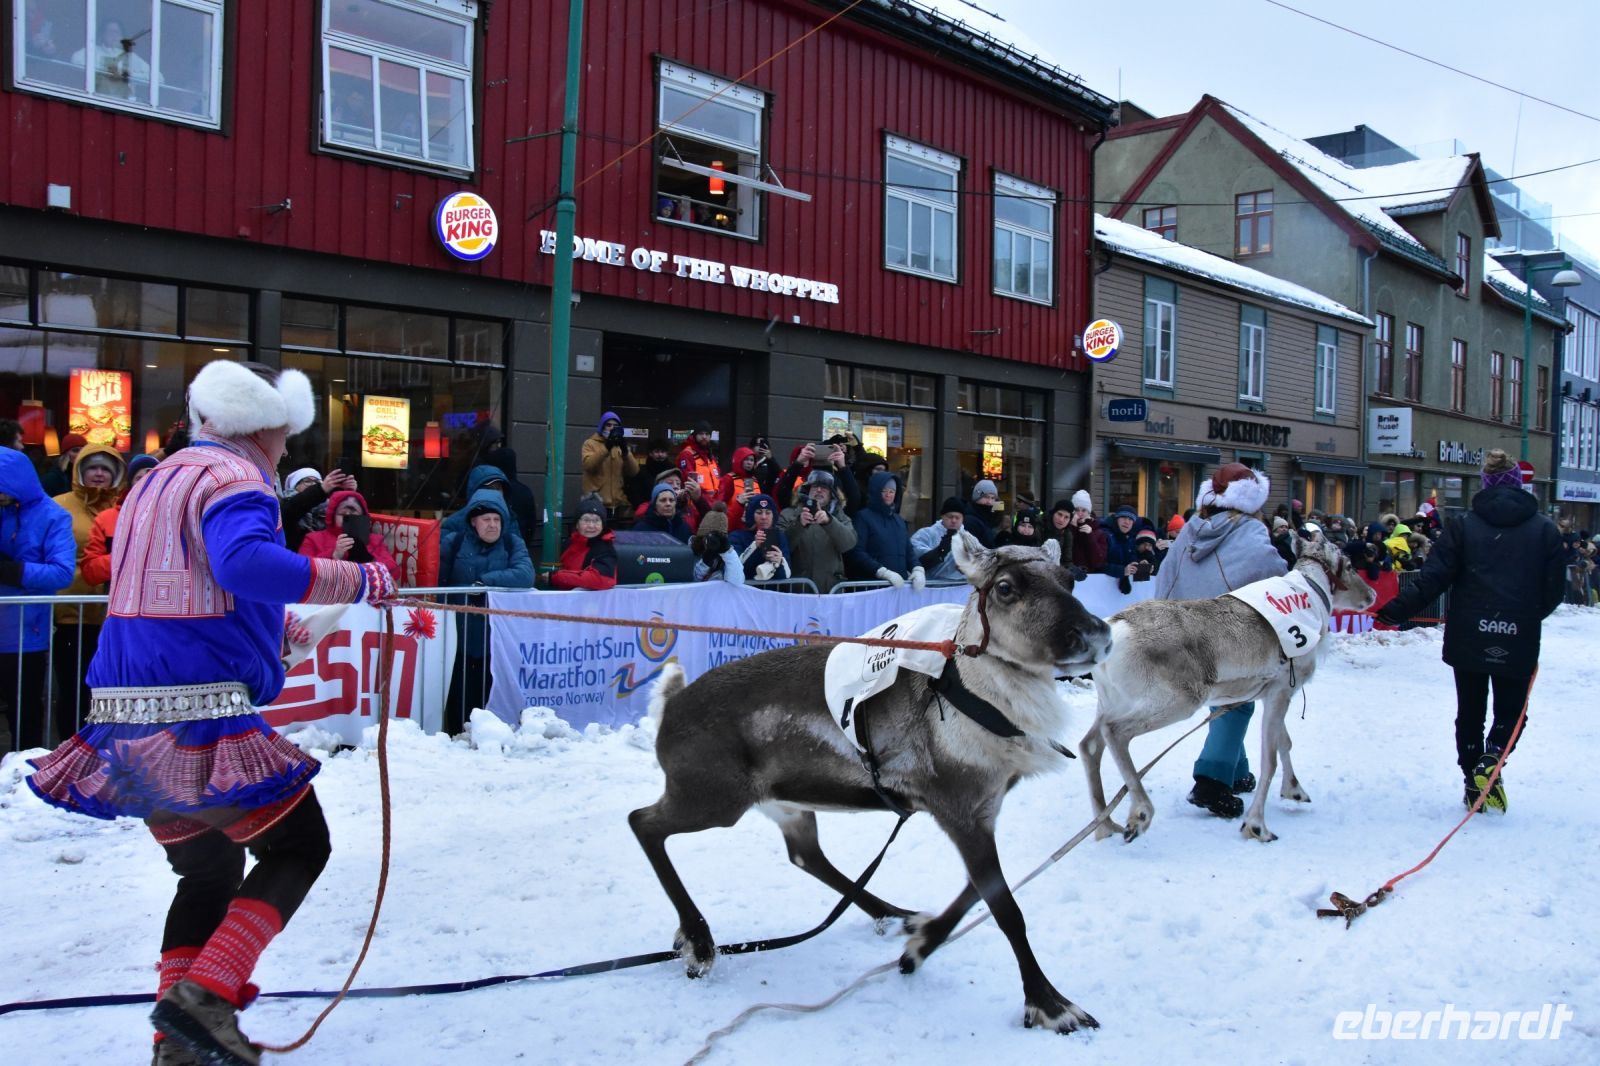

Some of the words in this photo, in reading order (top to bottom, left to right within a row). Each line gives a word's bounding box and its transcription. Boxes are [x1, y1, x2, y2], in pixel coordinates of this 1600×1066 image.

[445, 207, 491, 224] BURGER
[447, 220, 493, 242] KING
[631, 247, 668, 273] OF
[673, 254, 725, 284] THE
[730, 265, 839, 304] WHOPPER
[1085, 326, 1115, 342] BURGER
[1086, 333, 1115, 353] KING
[80, 370, 121, 390] KONGE
[80, 381, 121, 407] DEALS
[368, 398, 405, 409] GOURMET
[1111, 403, 1142, 416] norli
[1145, 415, 1175, 436] norli
[1207, 416, 1291, 448] BOKHUSET
[1439, 440, 1485, 465] Brillehuset
[1287, 625, 1308, 648] 3
[1478, 619, 1518, 635] SARA
[519, 637, 635, 665] MidnightSun
[519, 663, 605, 690] Marathon
